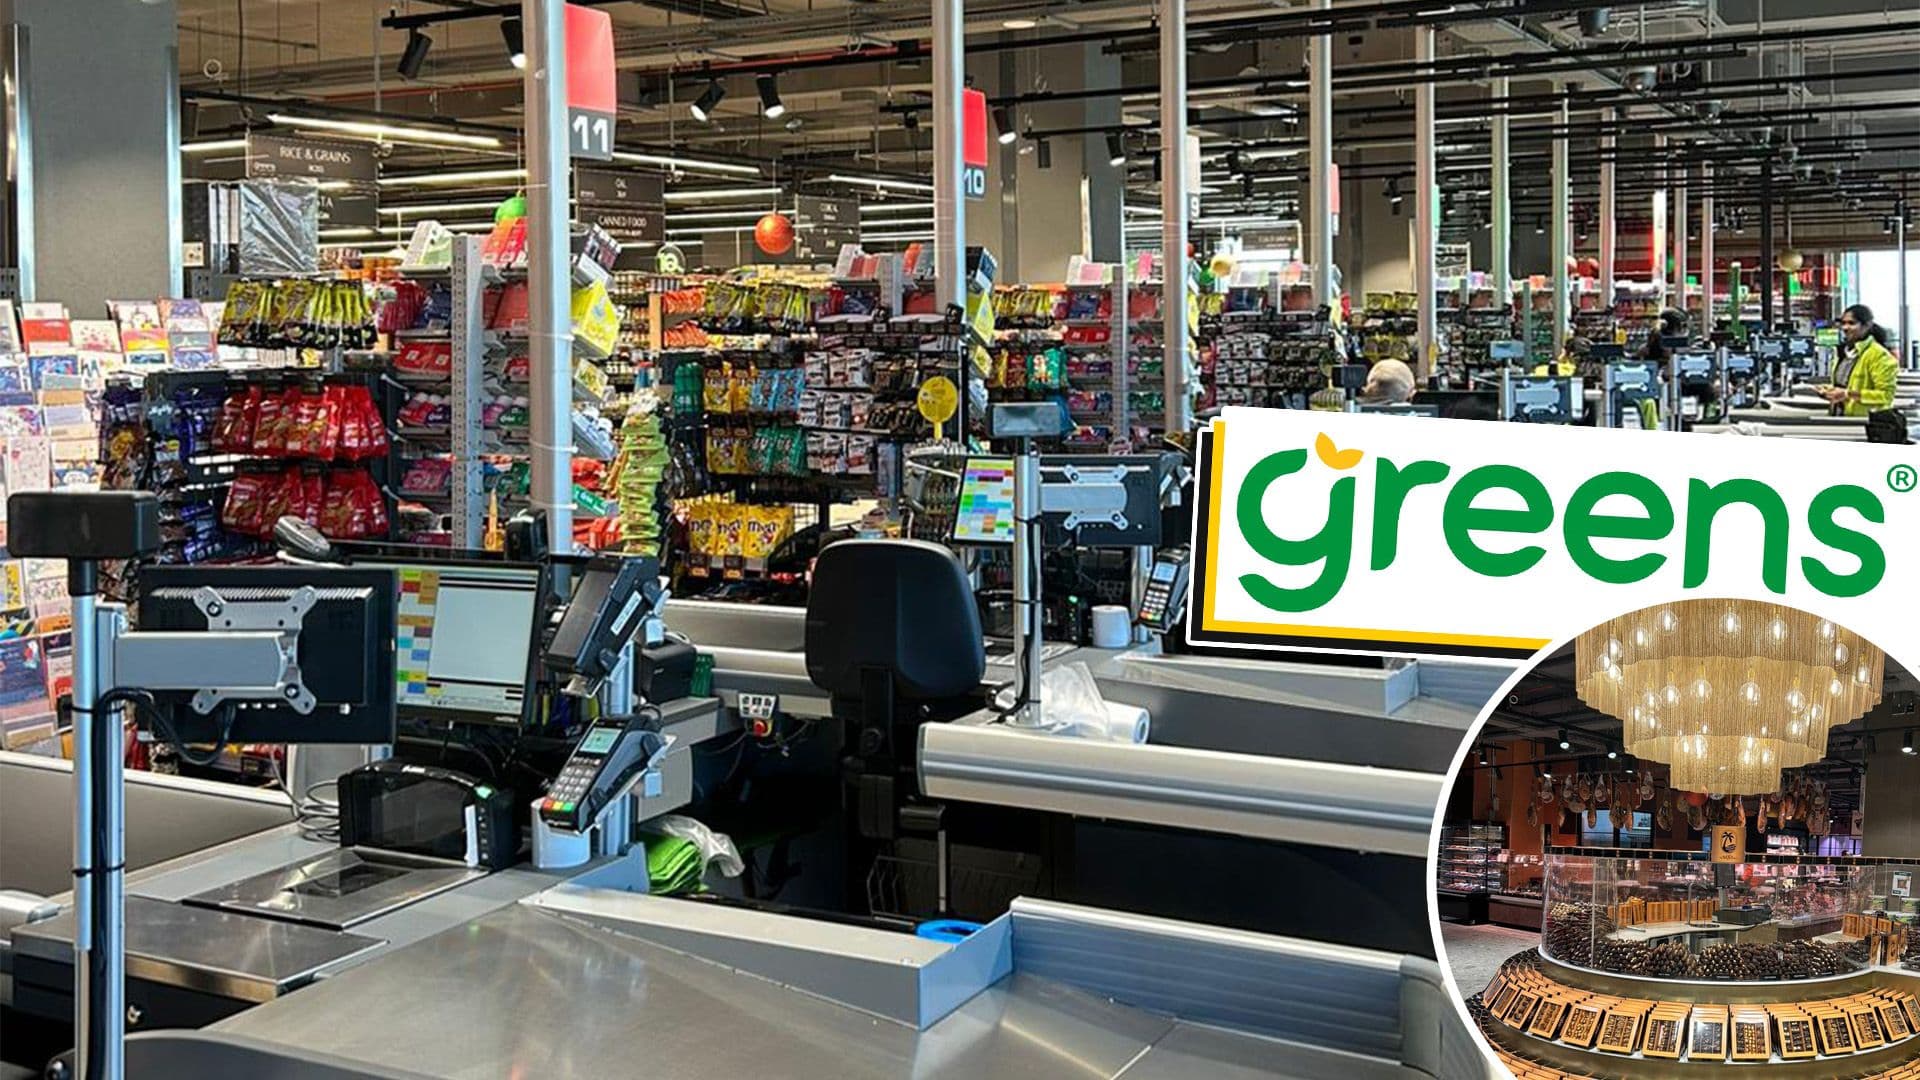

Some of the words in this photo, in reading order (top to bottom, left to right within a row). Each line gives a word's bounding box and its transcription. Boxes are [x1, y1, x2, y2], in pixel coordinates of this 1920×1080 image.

[572, 115, 609, 153] 11
[280, 146, 302, 160] RICE
[304, 148, 313, 160] &
[314, 149, 352, 164] GRAINS
[963, 168, 985, 195] 10
[1190, 196, 1200, 217] 9
[598, 215, 627, 227] CANNED
[628, 216, 648, 228] FOOD
